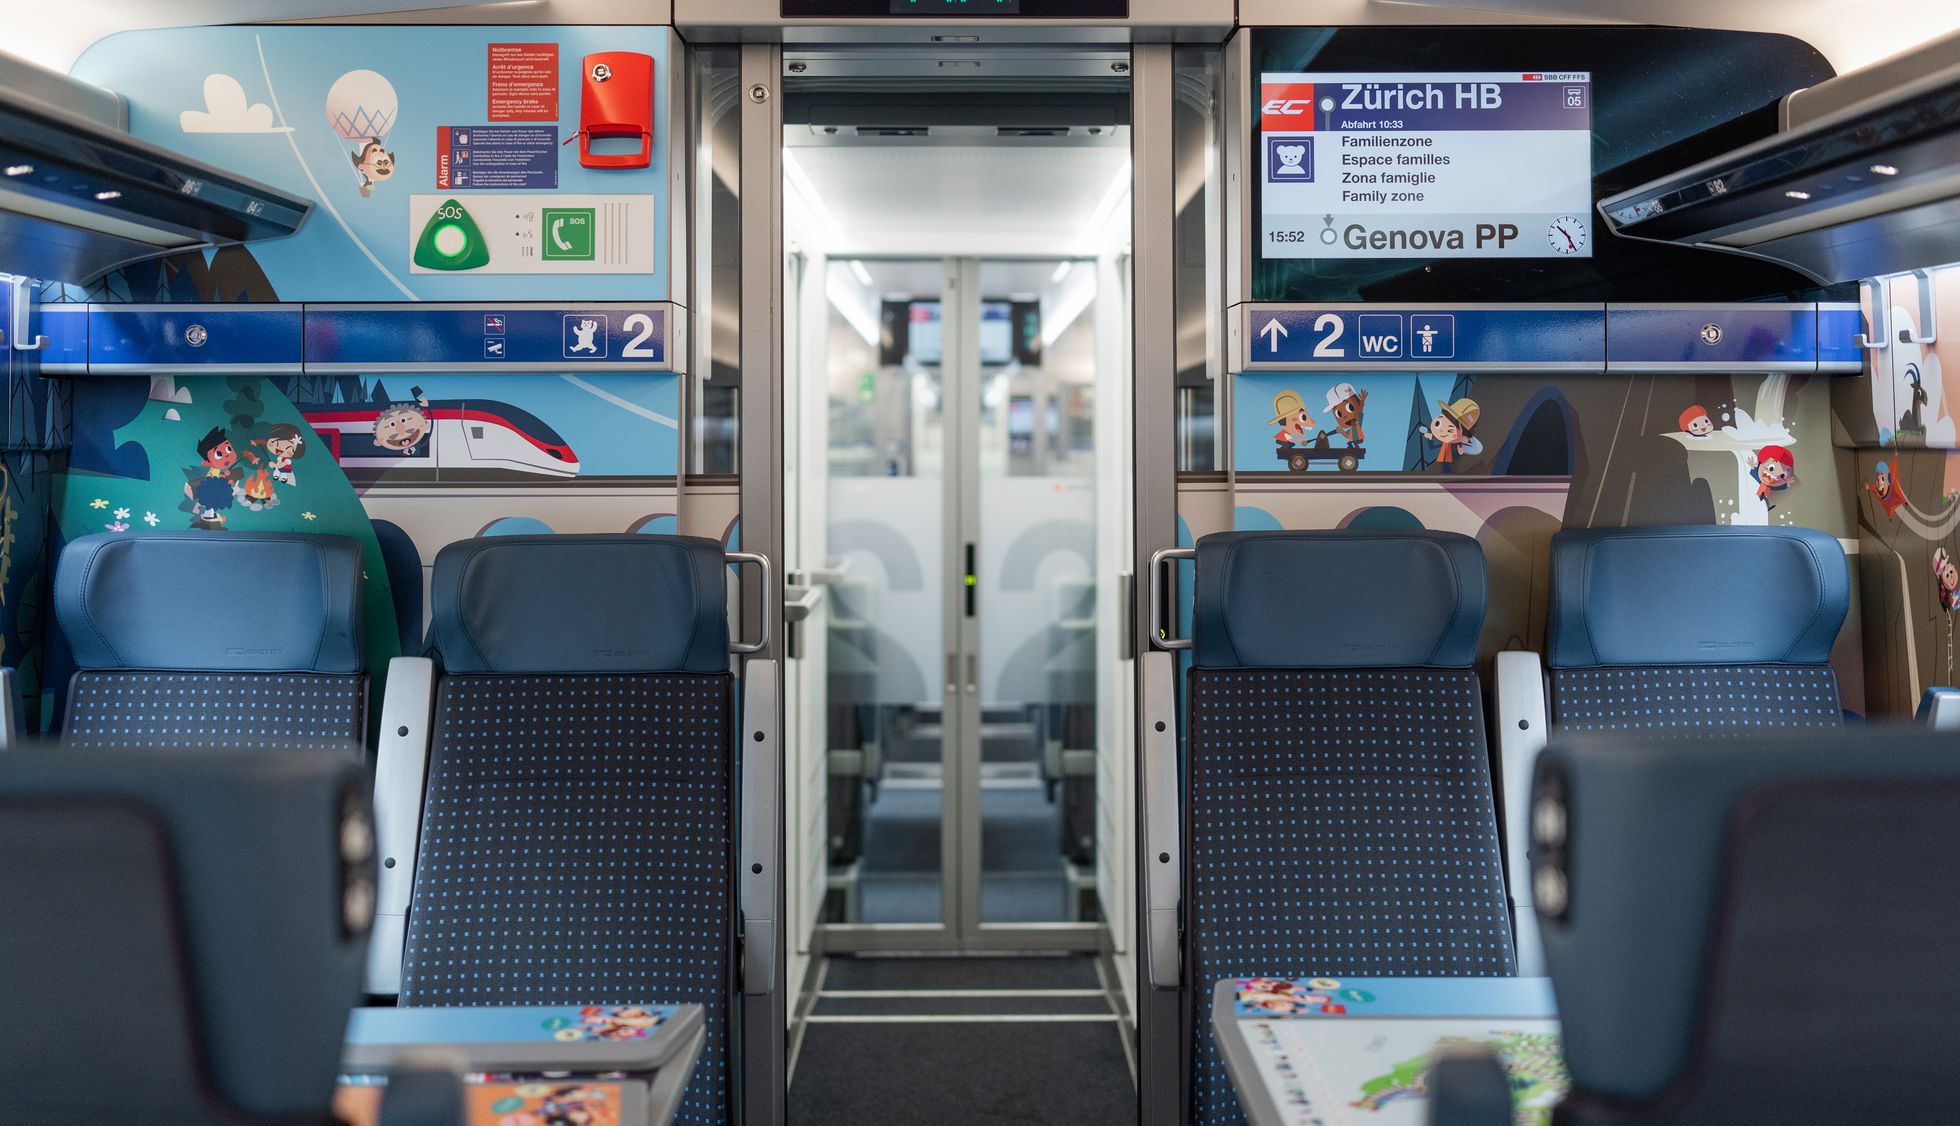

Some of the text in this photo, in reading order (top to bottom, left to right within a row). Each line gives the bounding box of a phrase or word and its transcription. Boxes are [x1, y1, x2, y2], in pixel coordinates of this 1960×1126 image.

[1341, 83, 1502, 110] Zürich HB
[1567, 96, 1582, 107] 05
[1262, 99, 1311, 115] EC
[1341, 120, 1404, 129] Abfahrt 10:33
[1342, 135, 1433, 147] Familienzone
[1342, 154, 1451, 168] Espace familles
[439, 154, 449, 187] Alarm
[1342, 172, 1436, 185] Zona famiglie
[1713, 179, 1728, 194] 82
[1342, 190, 1424, 204] Family zone
[437, 206, 463, 220] SOS
[569, 217, 585, 225] SOS
[1268, 231, 1305, 243] 15:52
[1343, 224, 1519, 250] Genova PP
[622, 313, 654, 358] 2
[1313, 313, 1399, 358] 2 WC
